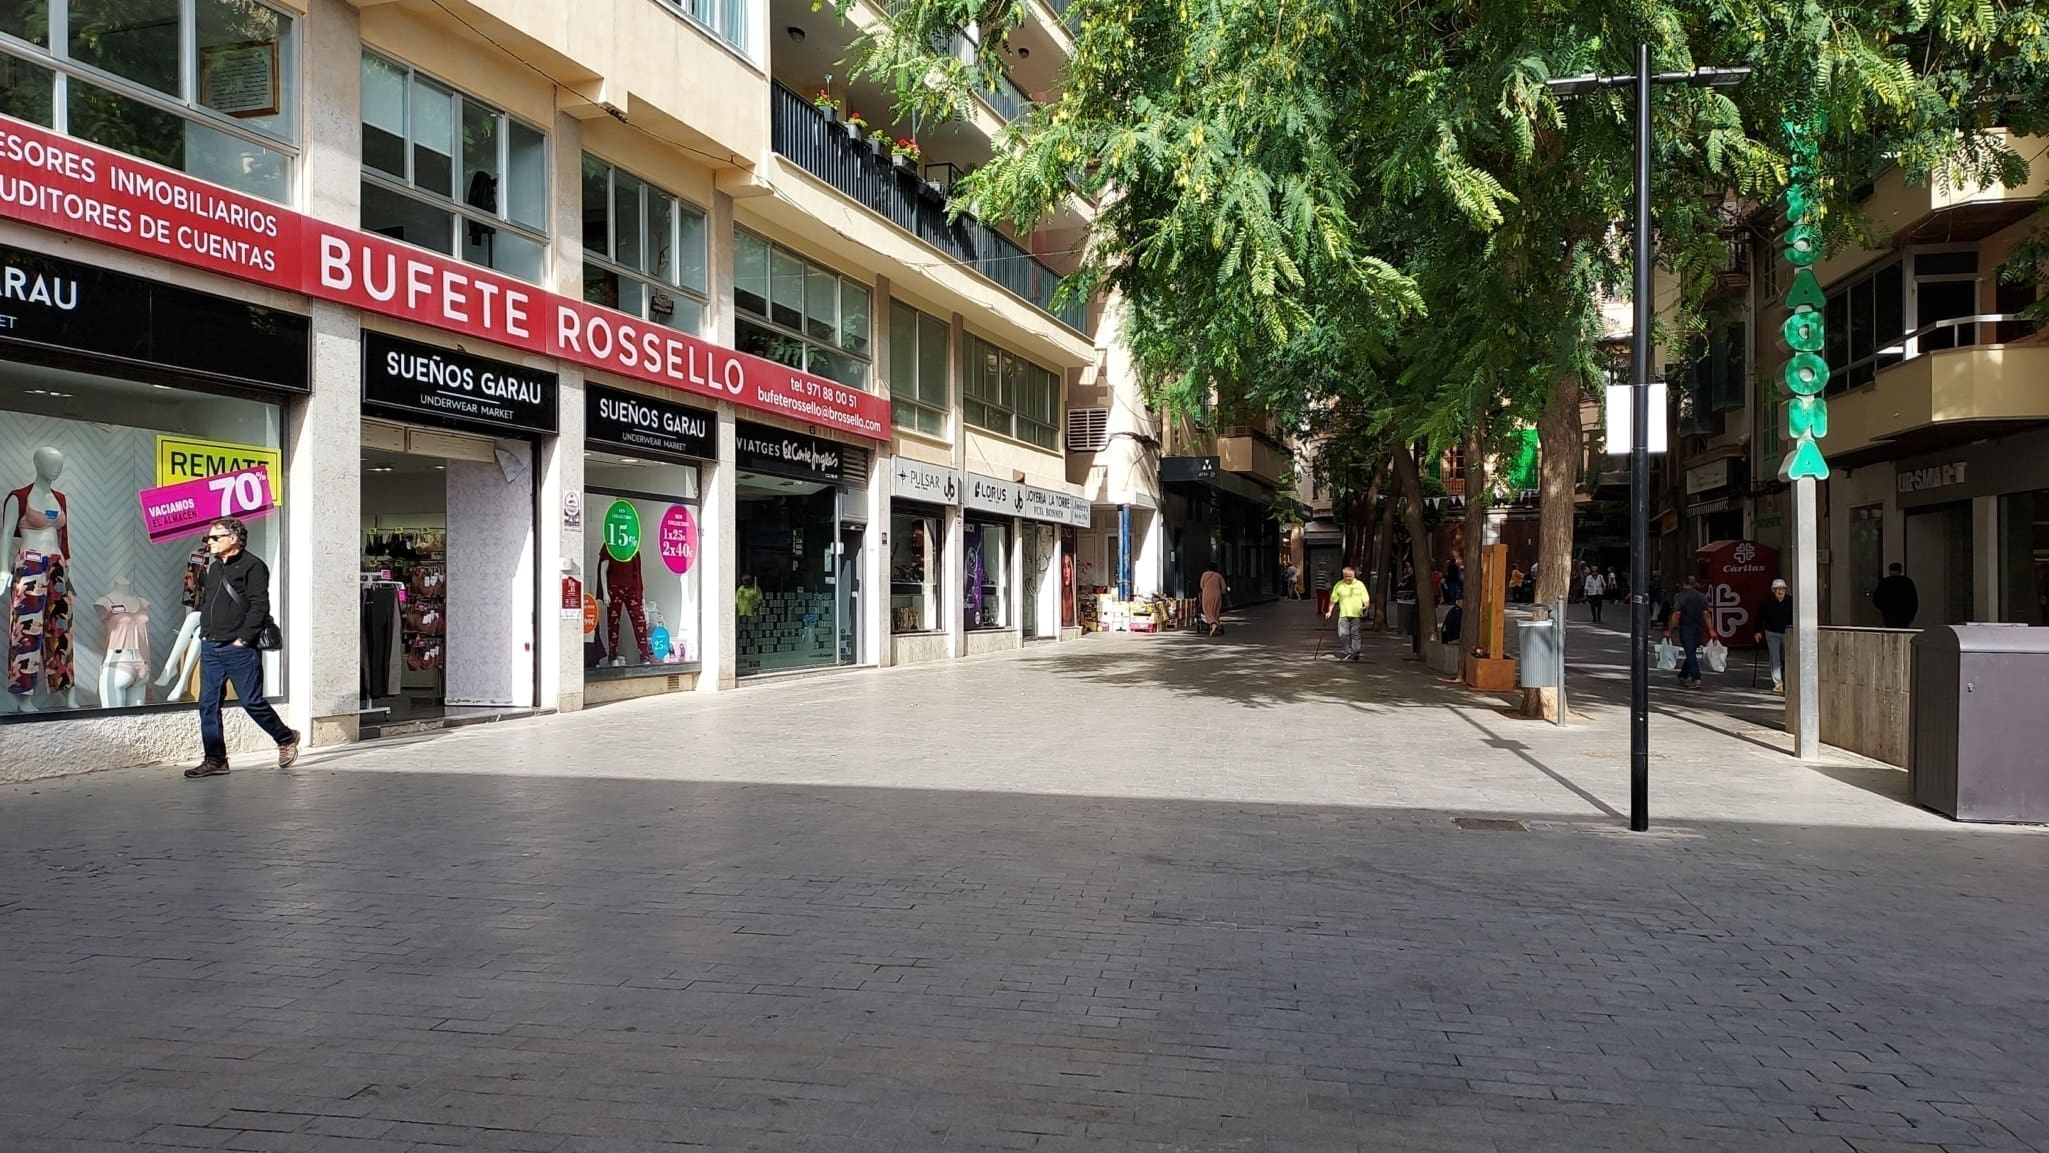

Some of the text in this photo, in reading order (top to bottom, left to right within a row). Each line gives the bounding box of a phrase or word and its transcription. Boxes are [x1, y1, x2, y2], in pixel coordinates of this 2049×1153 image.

[110, 166, 278, 238] INMOBILIARIOS
[139, 214, 171, 245] DE
[177, 226, 276, 272] CUENTAS
[0, 265, 78, 310] RAU
[320, 234, 745, 395] BUFETE ROSSELLO
[386, 351, 542, 405] SUEÑOS GARAU
[790, 376, 857, 409] tel. 971 88 00 51
[420, 393, 514, 420] UNDERWEAR MARKET
[599, 398, 706, 438] SUEÑOS GARAU
[757, 386, 882, 433] bufeterossello@brossello.com
[622, 432, 687, 451] UNDERWEAR MARKET
[736, 437, 781, 457] VIATGES
[791, 442, 812, 463] Corte
[170, 451, 269, 477] REMAT
[910, 470, 941, 489] PULSAR
[981, 484, 1007, 501] LORUS
[148, 498, 195, 517] VACIAMOS
[1048, 494, 1055, 506] LA
[152, 518, 162, 528] EL
